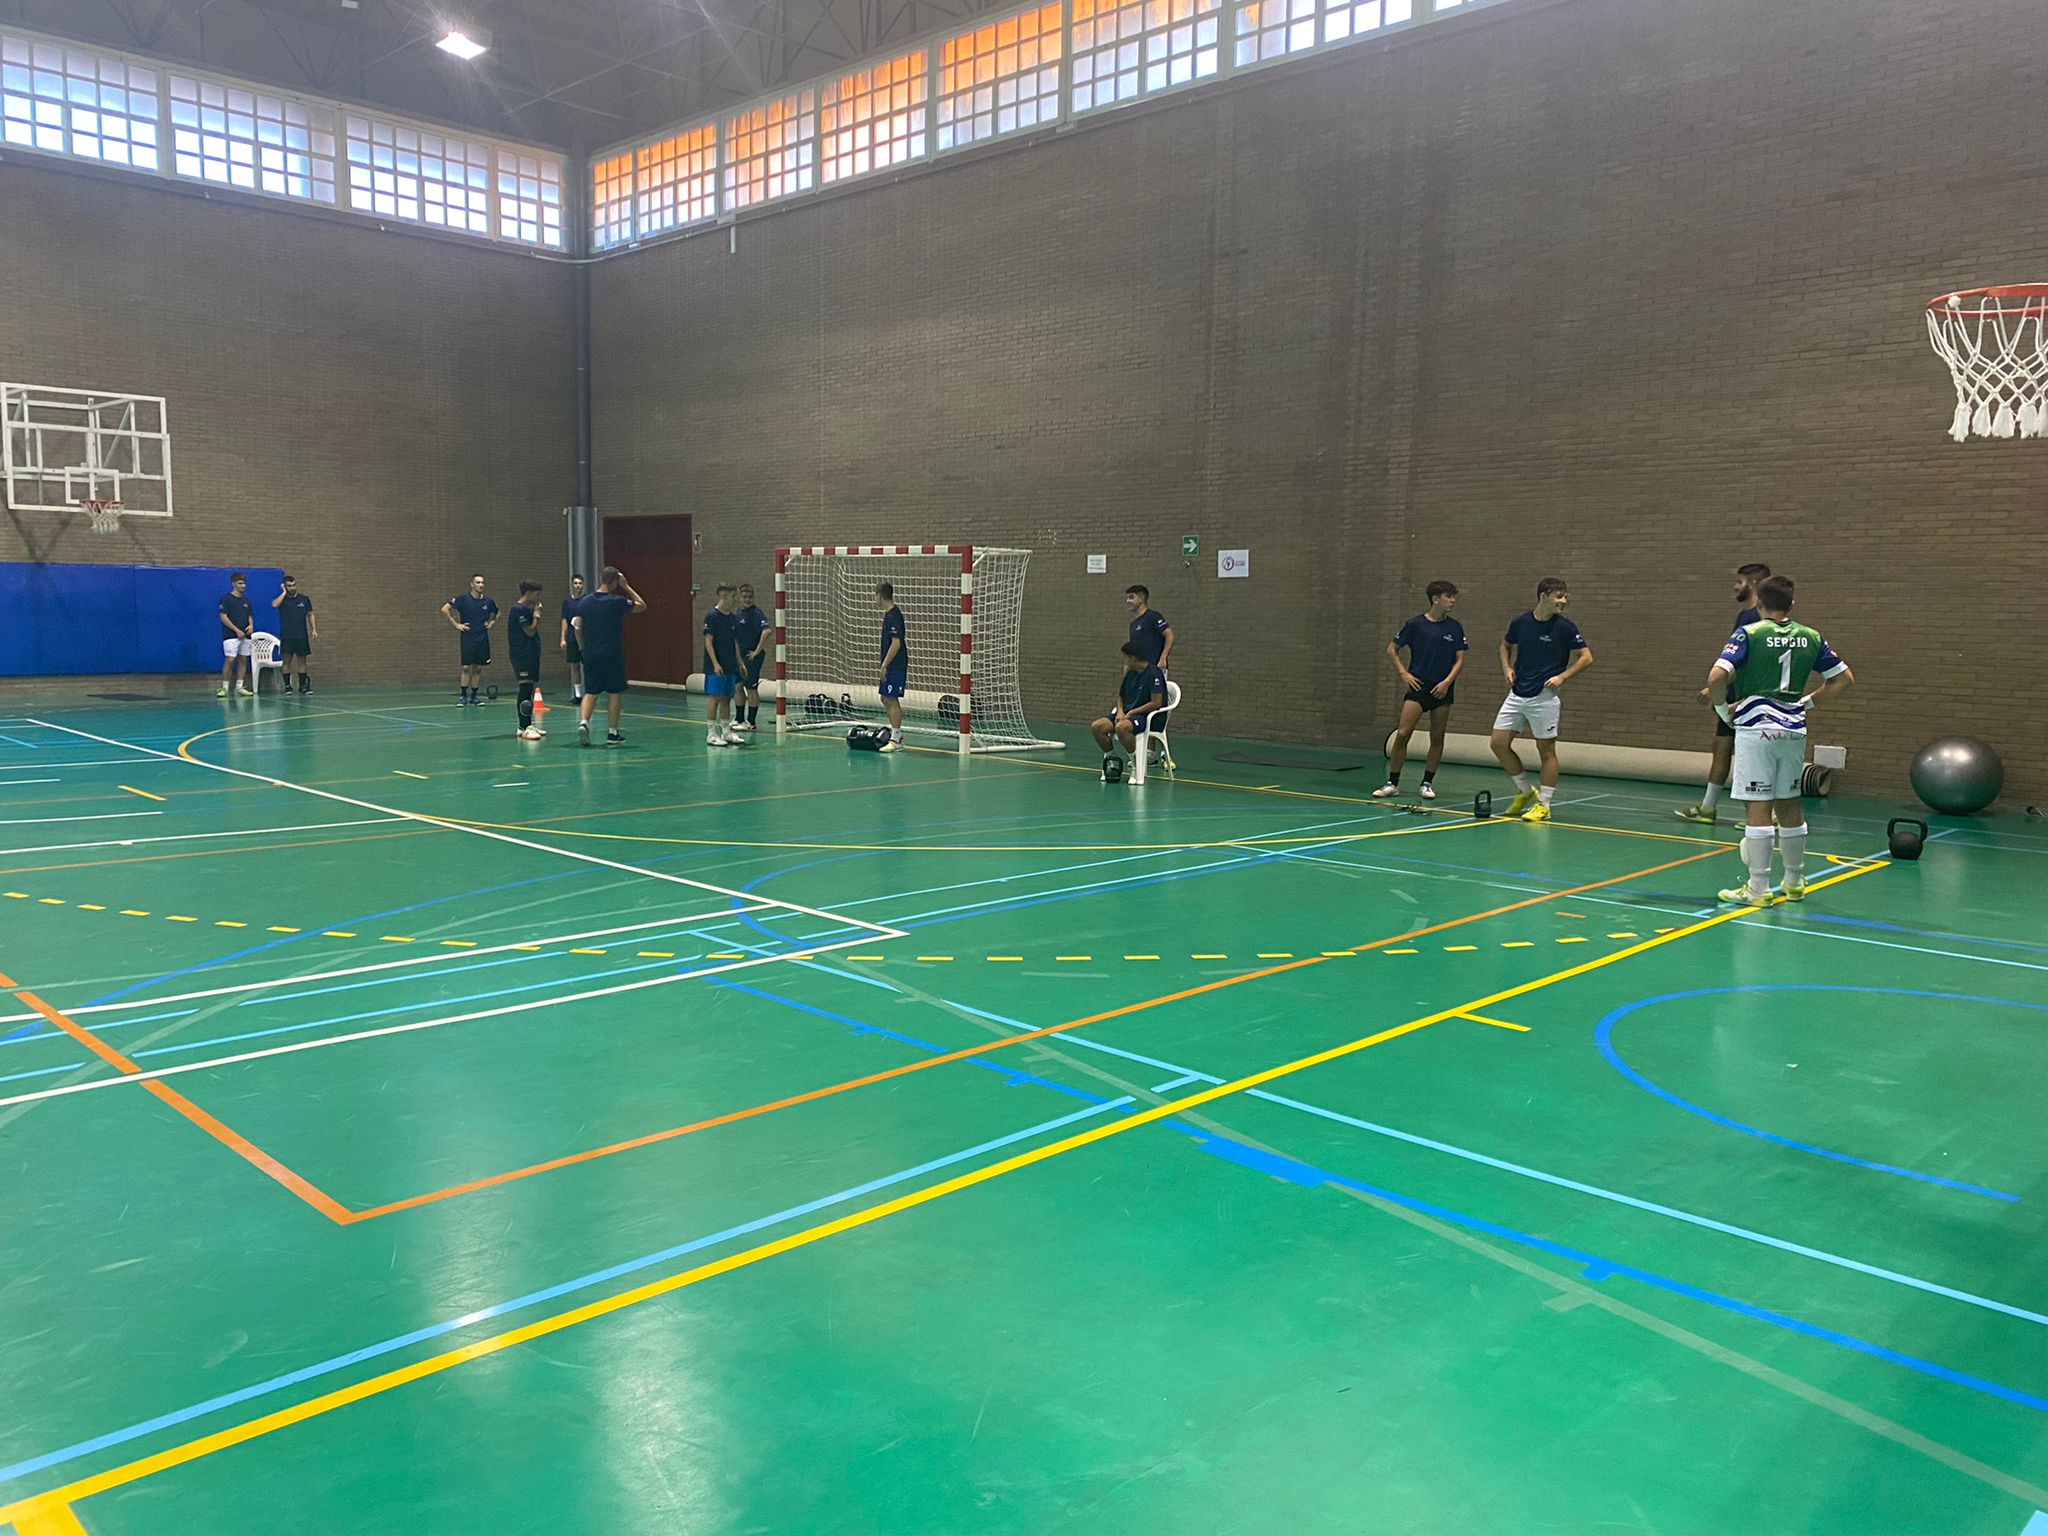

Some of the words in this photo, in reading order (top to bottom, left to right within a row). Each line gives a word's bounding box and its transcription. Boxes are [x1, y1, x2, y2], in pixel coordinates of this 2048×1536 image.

[1766, 636, 1808, 648] SERGIO
[1778, 649, 1792, 693] 1
[887, 684, 893, 694] 9
